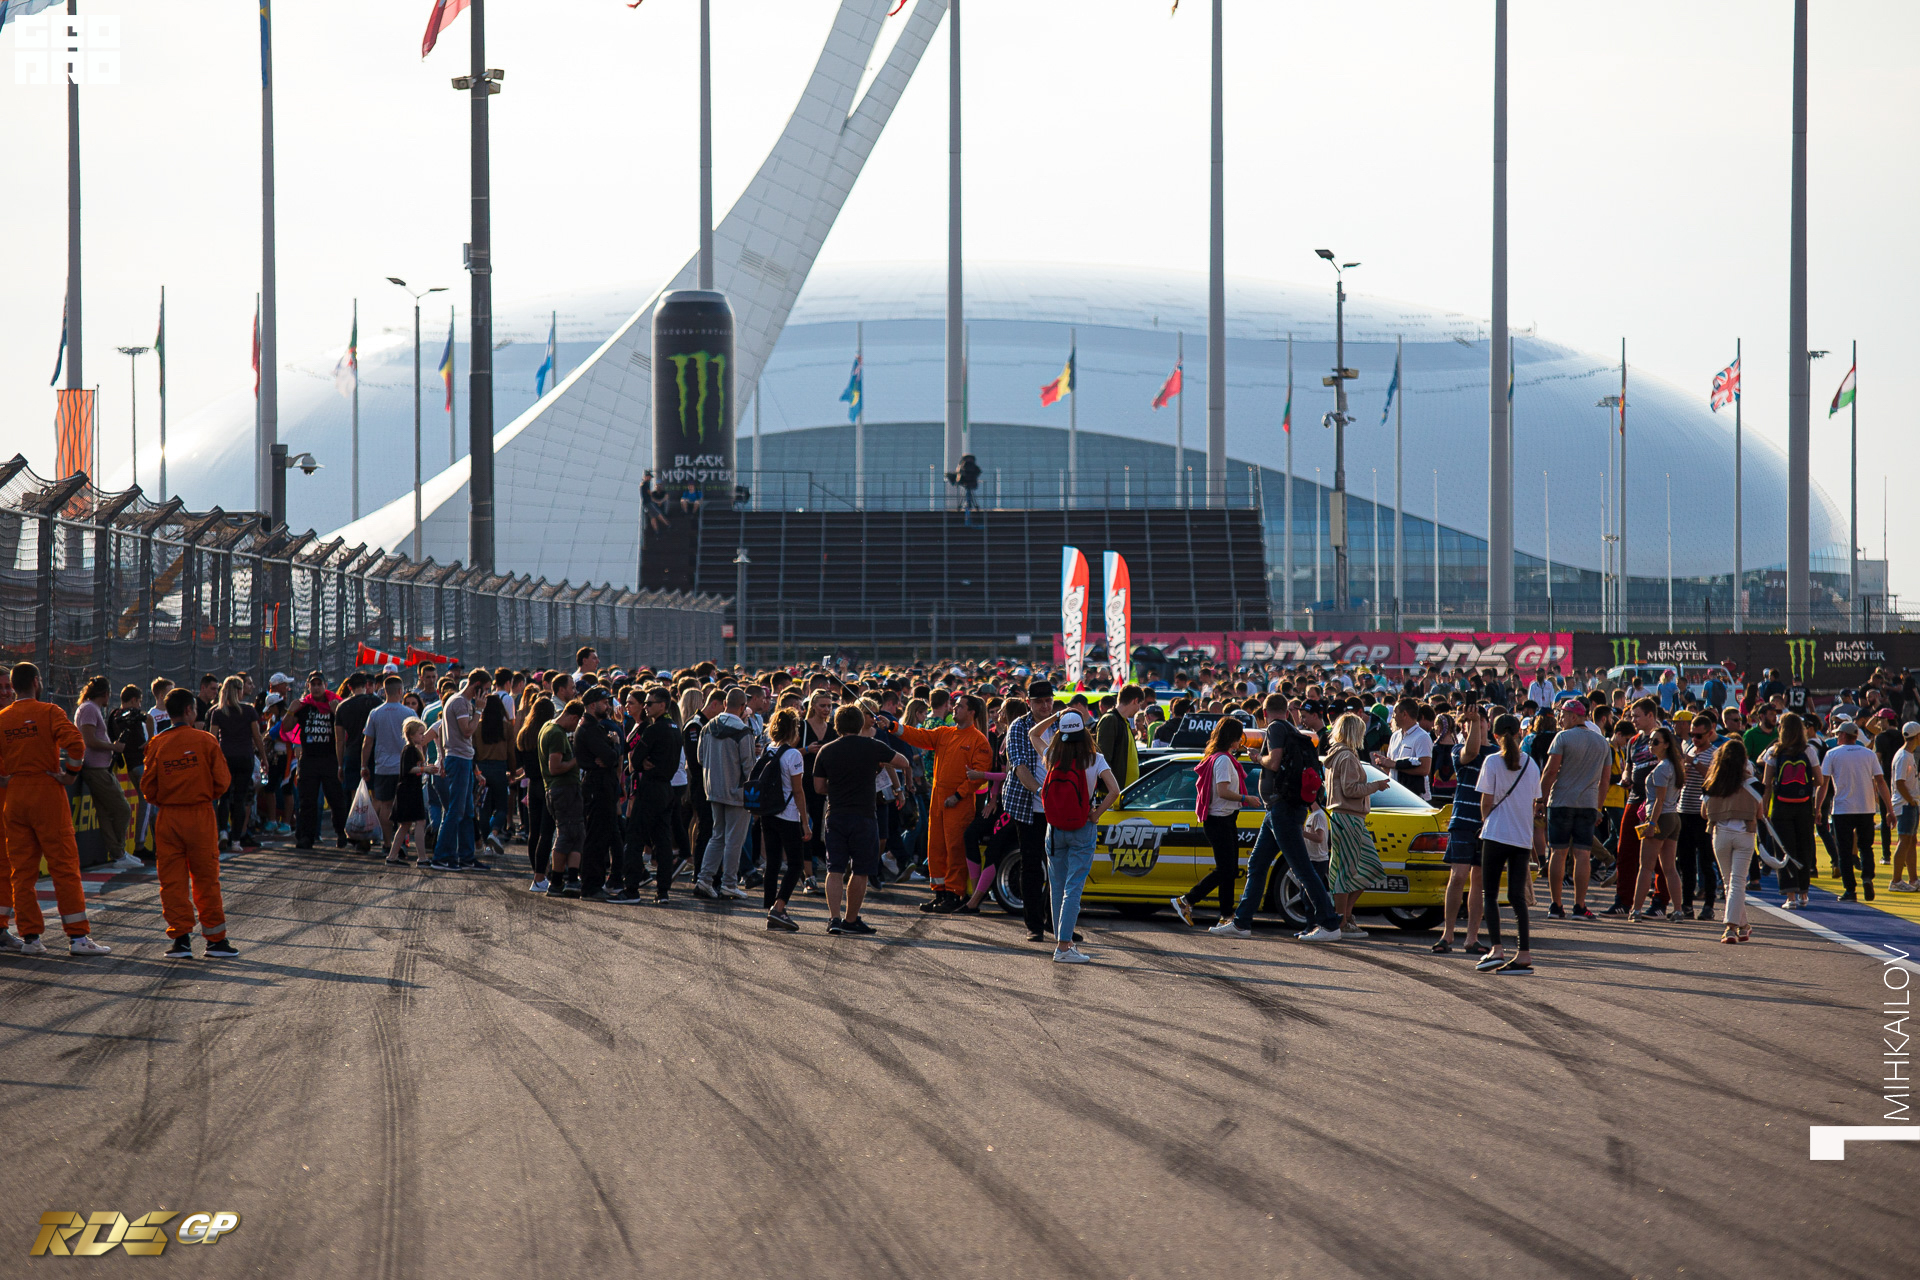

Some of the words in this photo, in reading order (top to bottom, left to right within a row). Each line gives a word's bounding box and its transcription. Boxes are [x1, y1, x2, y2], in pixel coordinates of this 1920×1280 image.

[674, 454, 725, 467] BLACK
[661, 467, 733, 483] MONSTER
[1658, 640, 1698, 651] BLACK
[1835, 640, 1875, 651] BLACK
[1341, 644, 1391, 663] GP
[1514, 644, 1570, 671] GP
[1646, 650, 1709, 662] MONSTER
[1823, 650, 1886, 662] MONSTER
[1789, 691, 1806, 707] 13
[4, 726, 38, 738] SOCHI
[163, 755, 198, 769] SOCHI
[1104, 824, 1169, 851] DRIFT
[1112, 848, 1154, 871] TAXI
